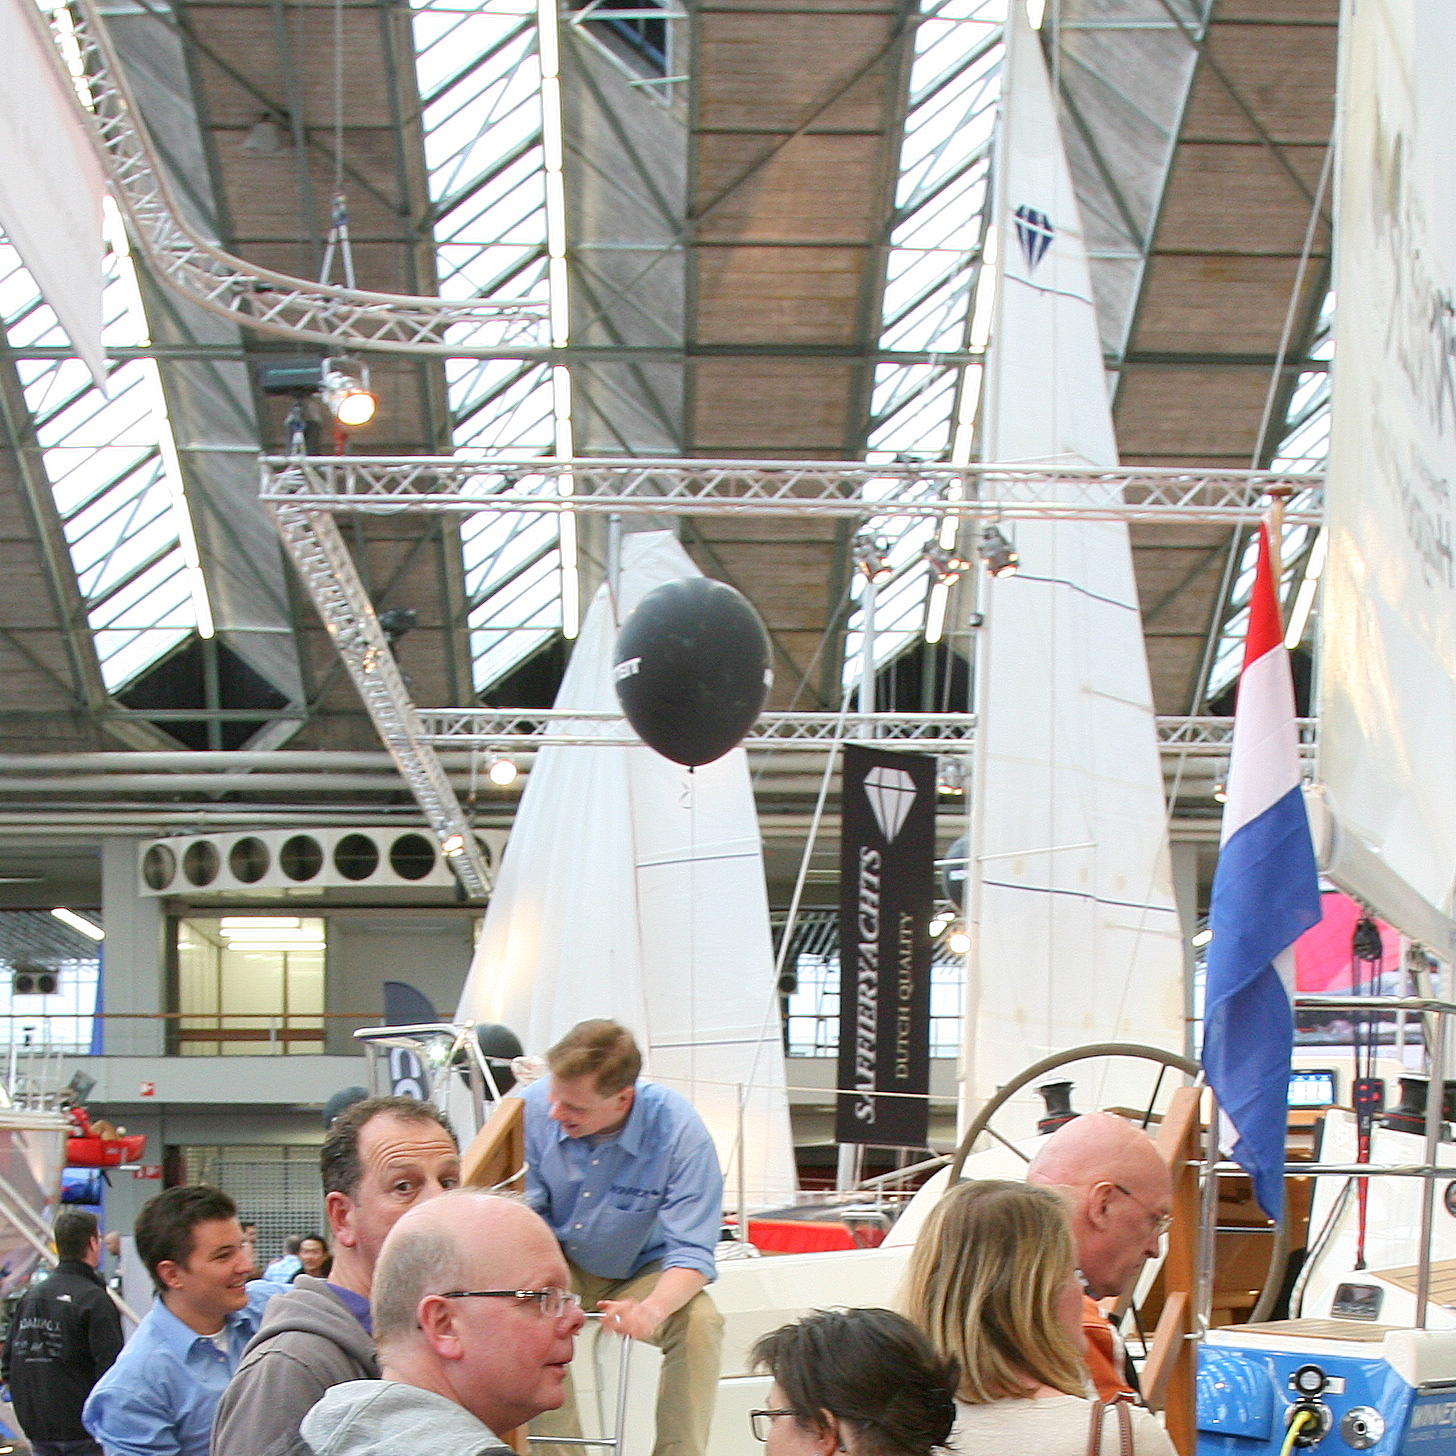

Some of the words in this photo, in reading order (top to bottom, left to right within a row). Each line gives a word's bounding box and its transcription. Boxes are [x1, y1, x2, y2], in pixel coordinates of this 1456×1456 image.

[855, 845, 882, 1125] SAFFIERYACHTS
[898, 910, 915, 1001] QUALITY
[895, 1006, 913, 1079] DUTCH
